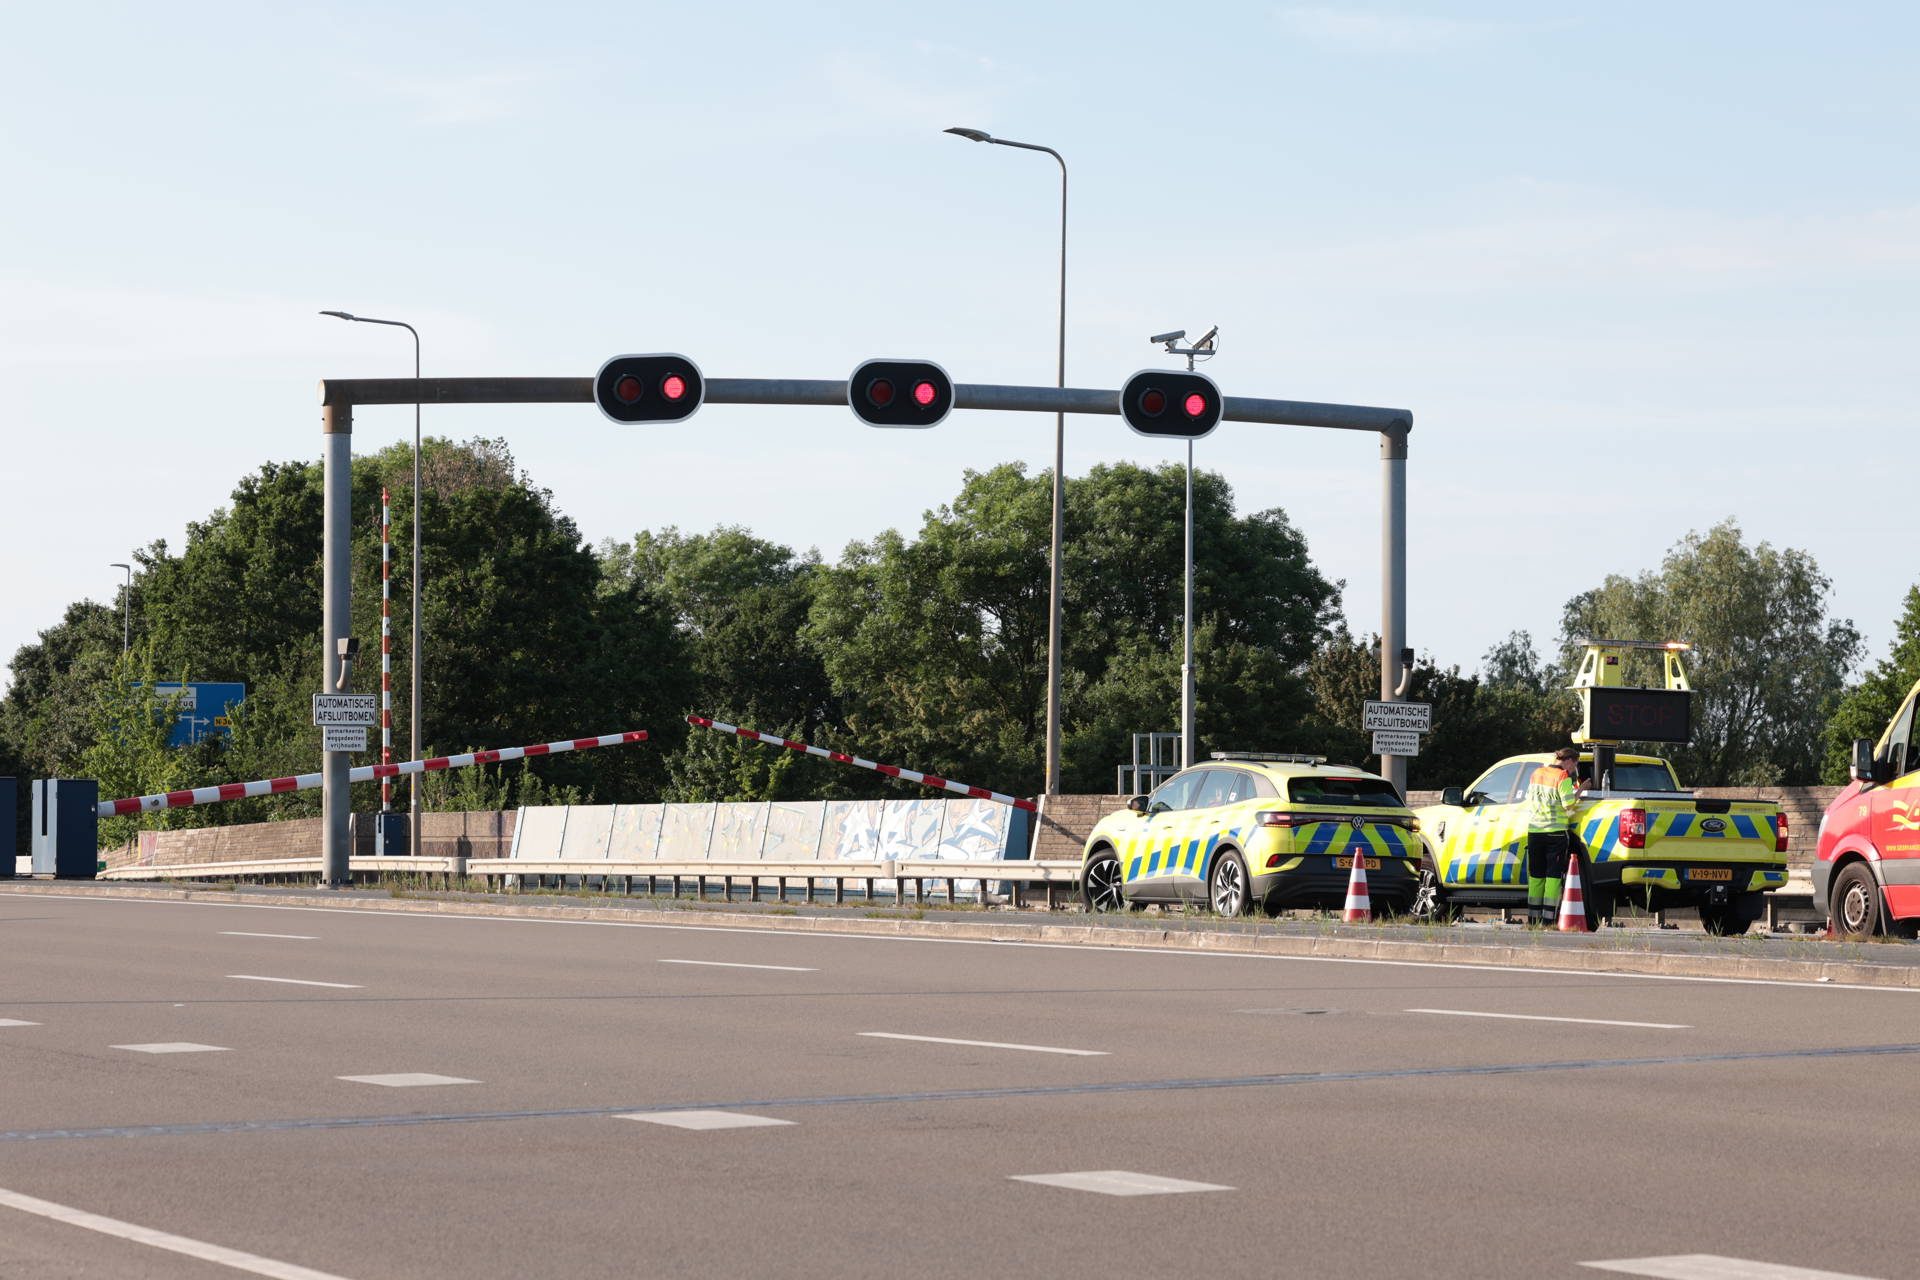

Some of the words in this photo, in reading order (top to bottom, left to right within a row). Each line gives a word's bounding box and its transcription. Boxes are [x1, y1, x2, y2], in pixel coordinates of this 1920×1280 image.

[317, 698, 375, 709] AUTOMATISCHE
[317, 711, 375, 721] AFSLUITBOMEN
[1367, 705, 1428, 717] AUTOMATISCHE
[1608, 704, 1674, 725] STOP
[1367, 717, 1428, 729] AFSLUITBOMEN
